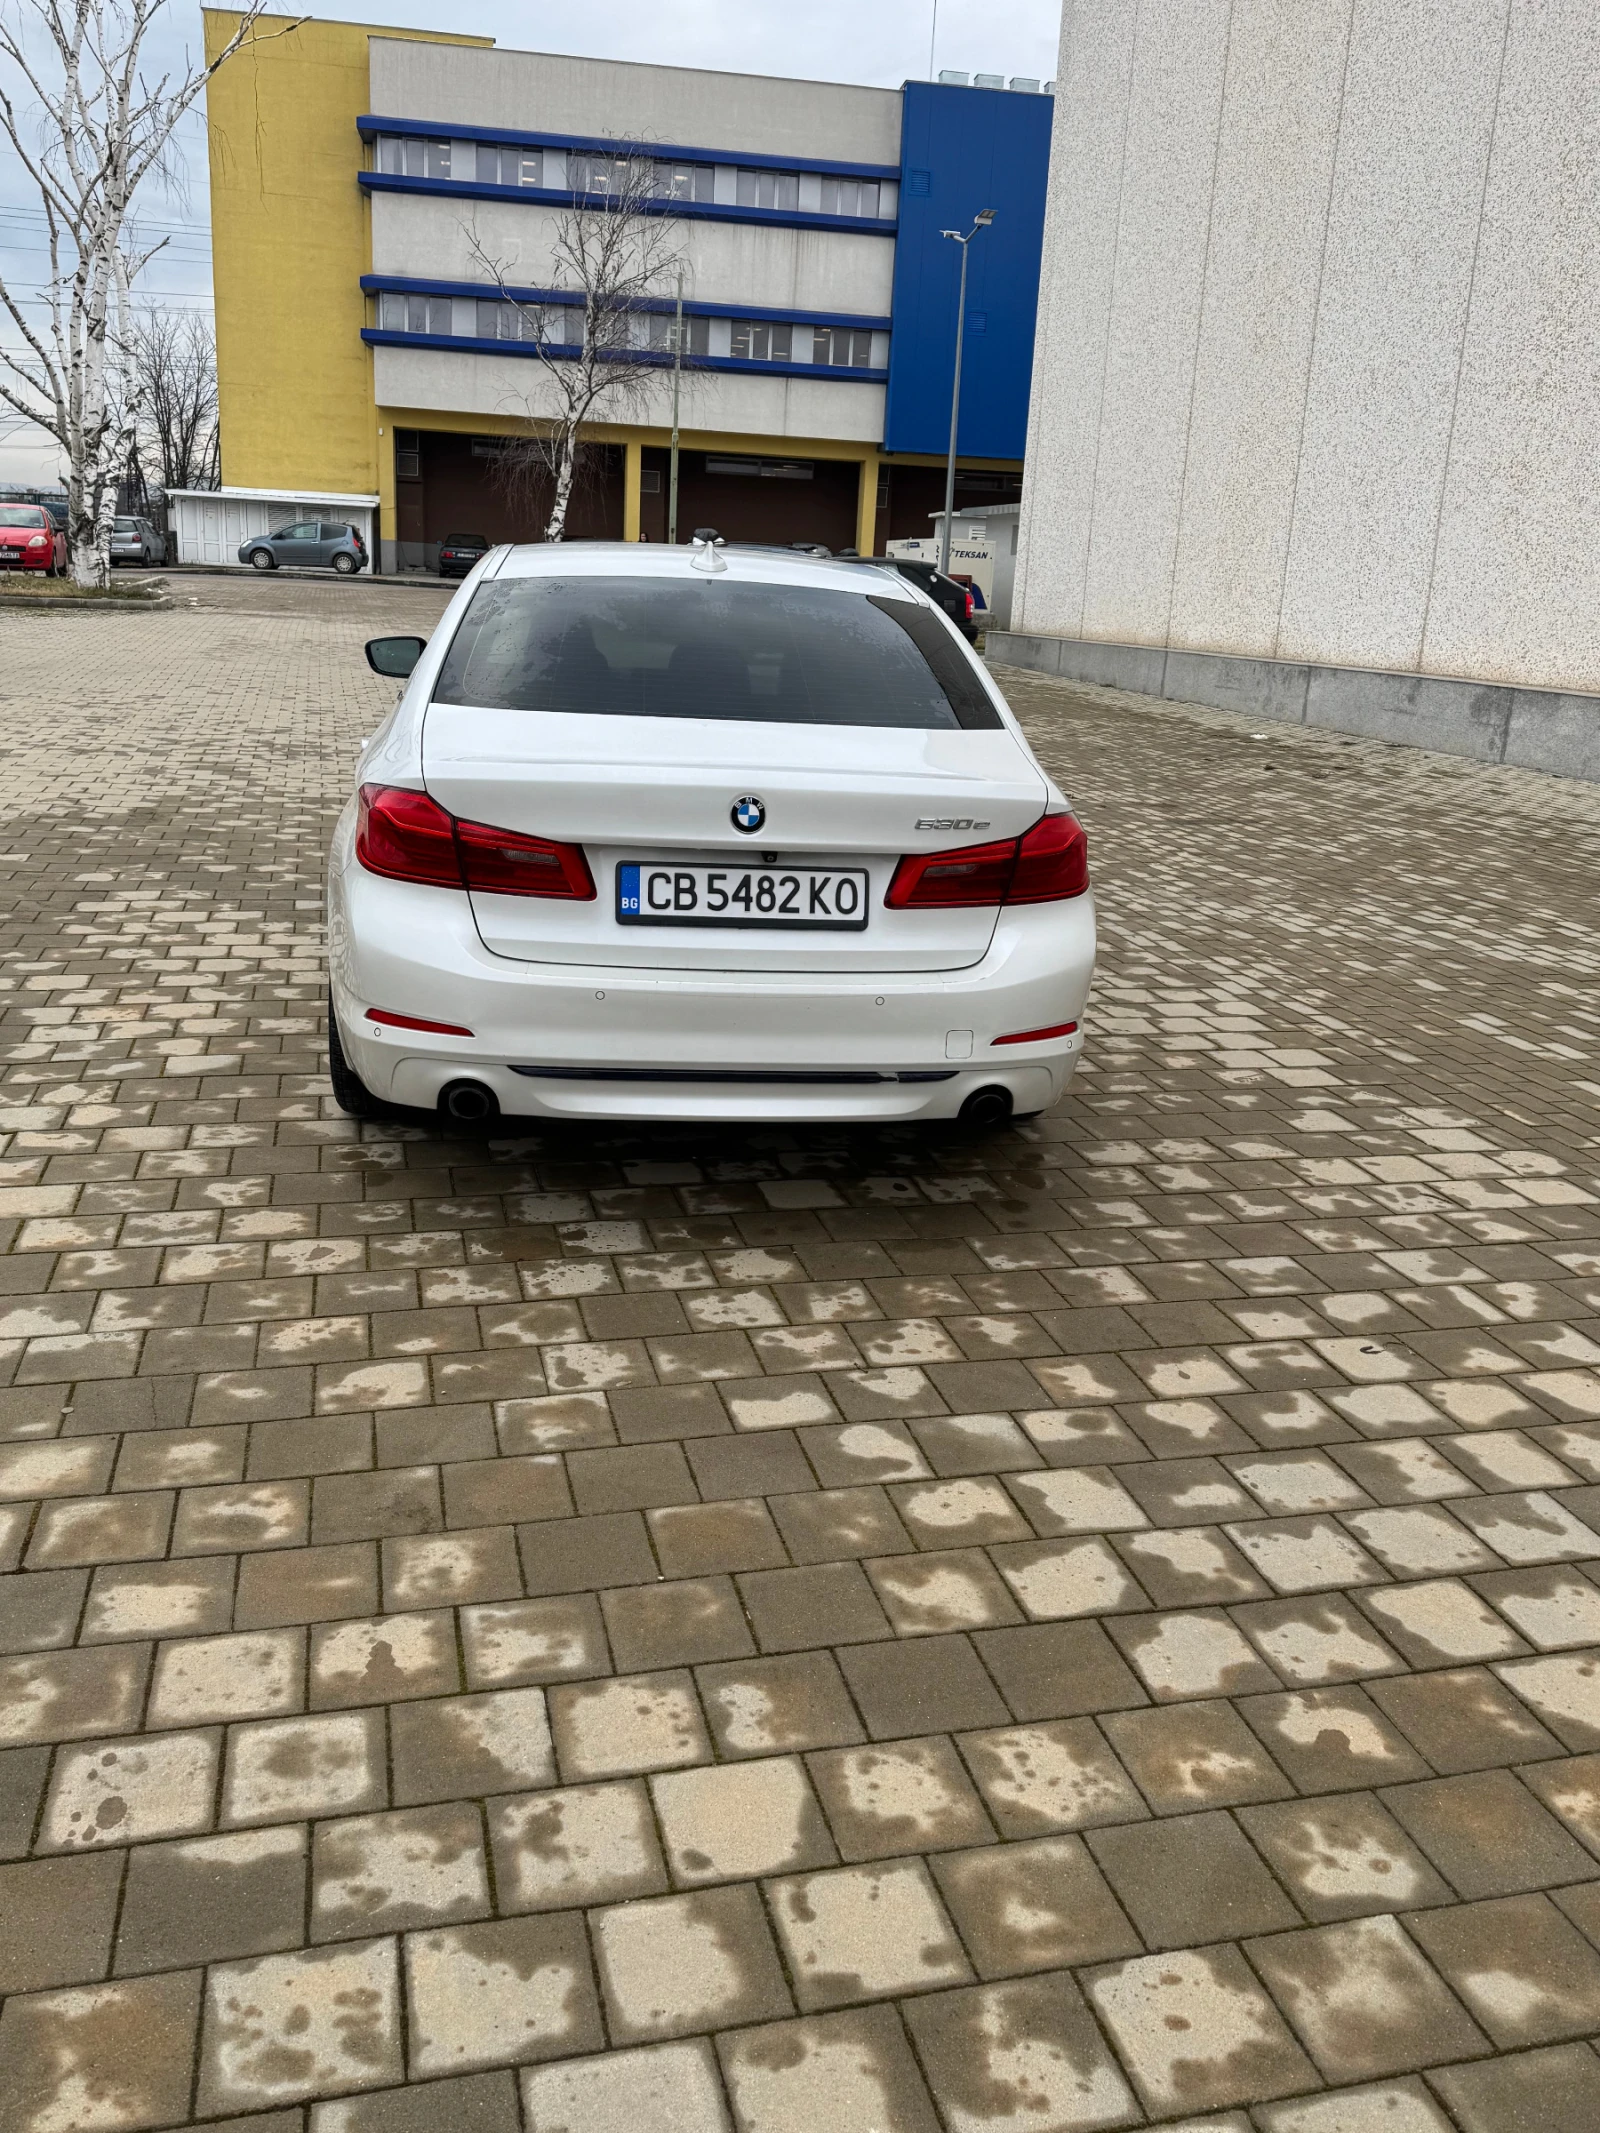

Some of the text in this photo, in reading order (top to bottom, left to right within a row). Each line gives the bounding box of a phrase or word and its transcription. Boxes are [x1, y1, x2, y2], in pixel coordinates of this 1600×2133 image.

[954, 550, 989, 559] TEKSAN
[734, 797, 764, 810] BMW
[621, 897, 638, 909] BG
